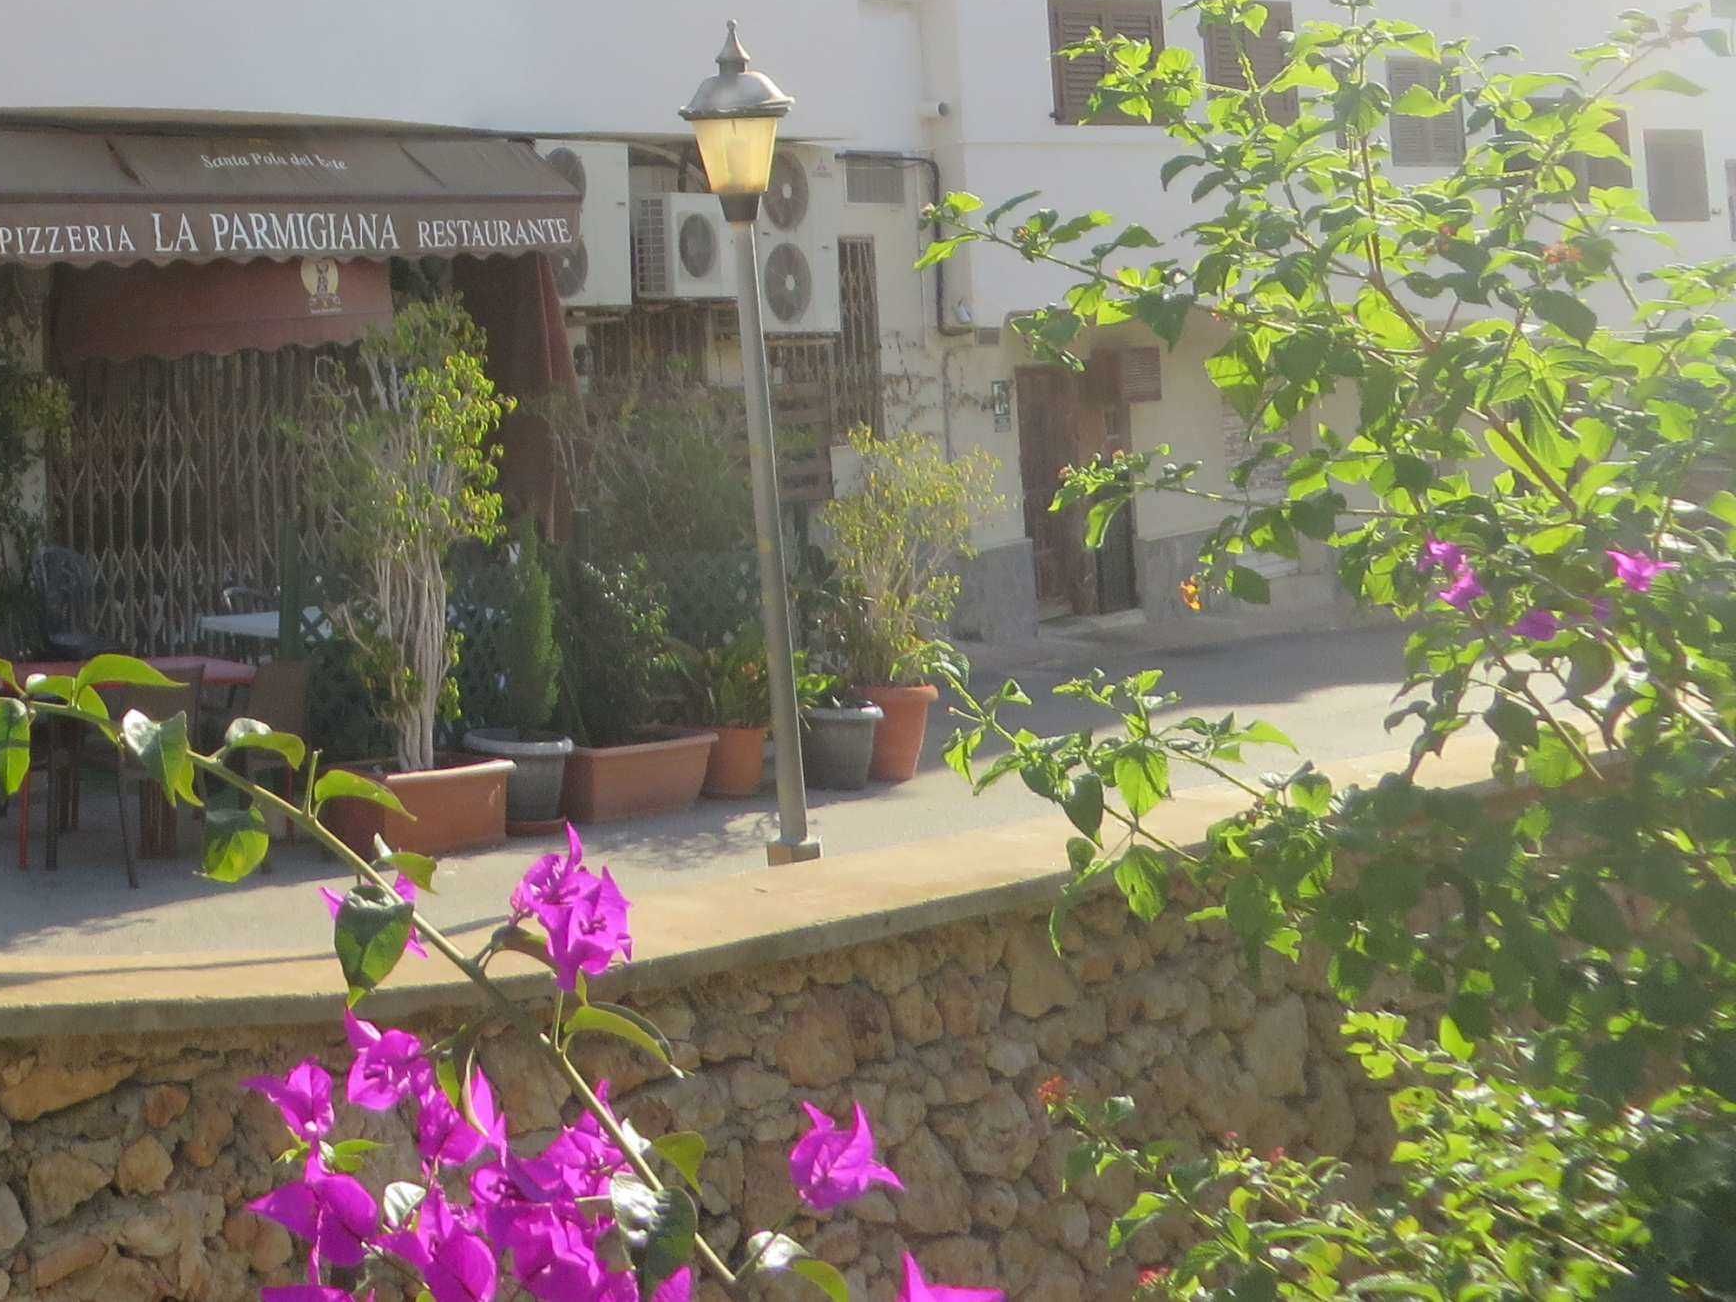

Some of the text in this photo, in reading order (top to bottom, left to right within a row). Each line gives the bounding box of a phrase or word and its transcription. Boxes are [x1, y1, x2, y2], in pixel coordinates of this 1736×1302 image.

[151, 212, 200, 253] LA
[209, 211, 401, 251] PARMIGIANA
[416, 217, 574, 249] RESTAURANTE
